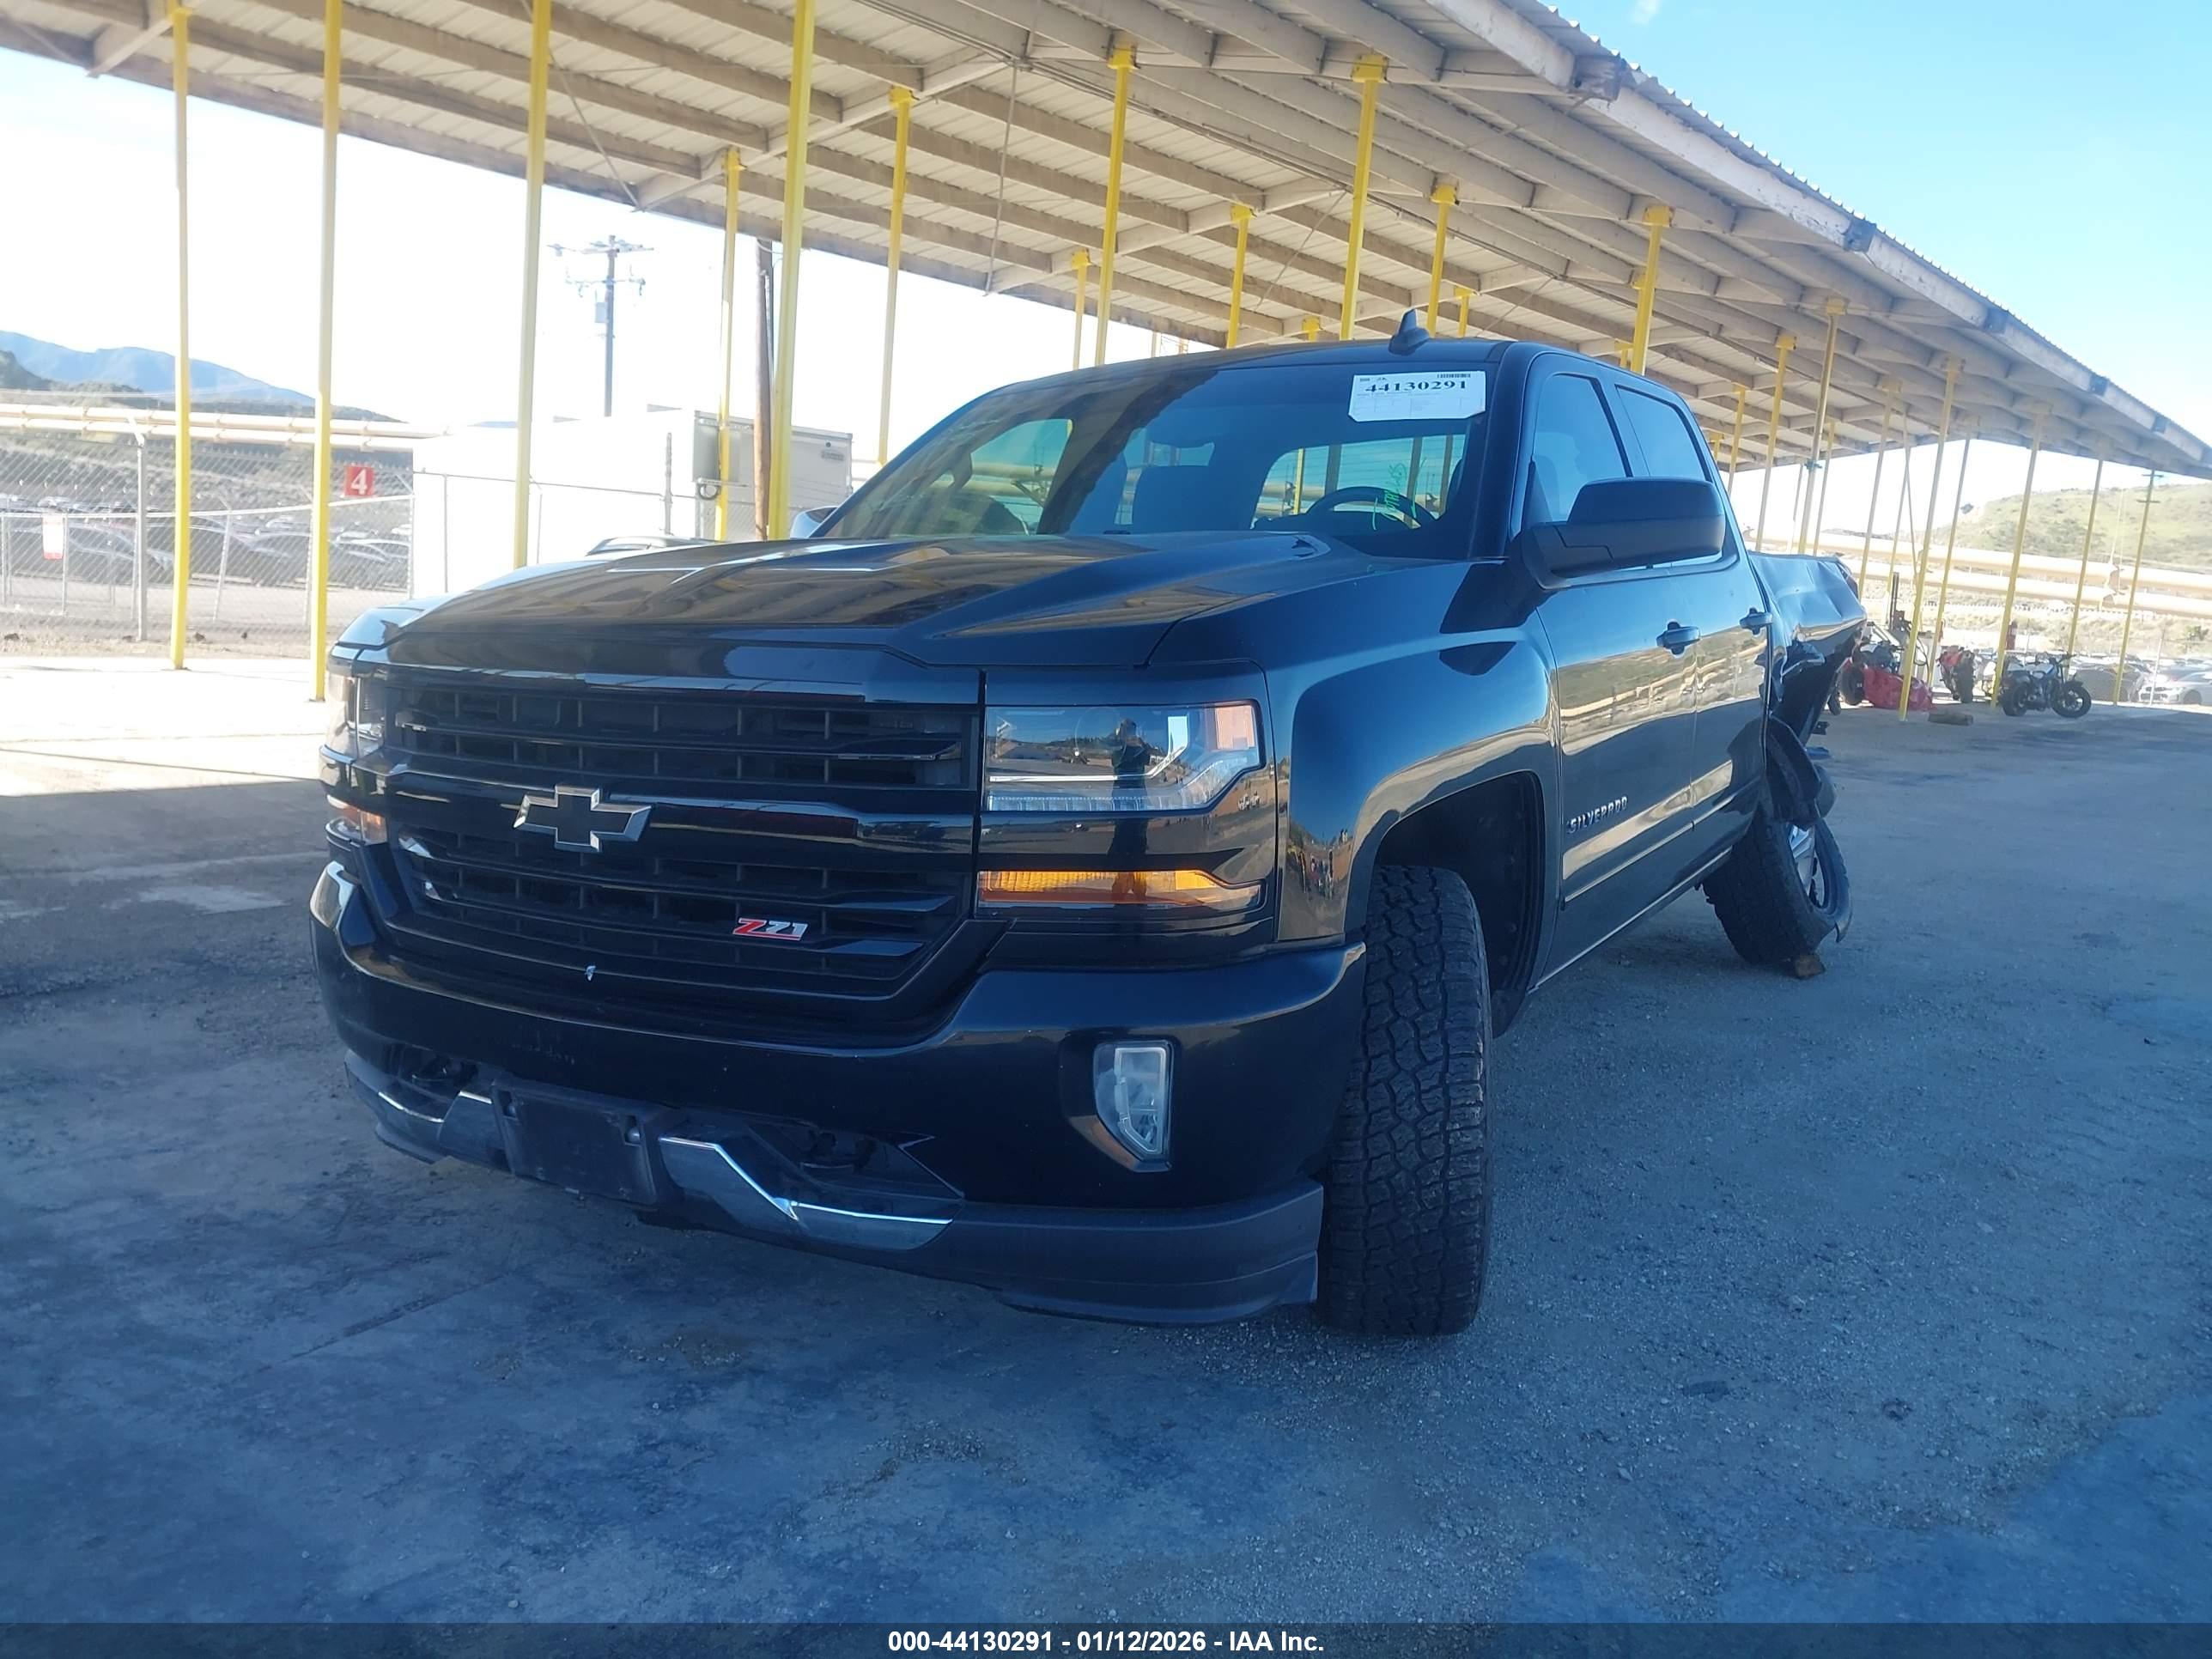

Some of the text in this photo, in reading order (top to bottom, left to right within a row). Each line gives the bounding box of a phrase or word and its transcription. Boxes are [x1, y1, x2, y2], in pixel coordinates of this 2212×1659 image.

[1364, 380, 1467, 393] 44130291
[350, 468, 368, 495] 4
[1567, 795, 1628, 834] SILVERADO
[732, 917, 809, 941] Z71
